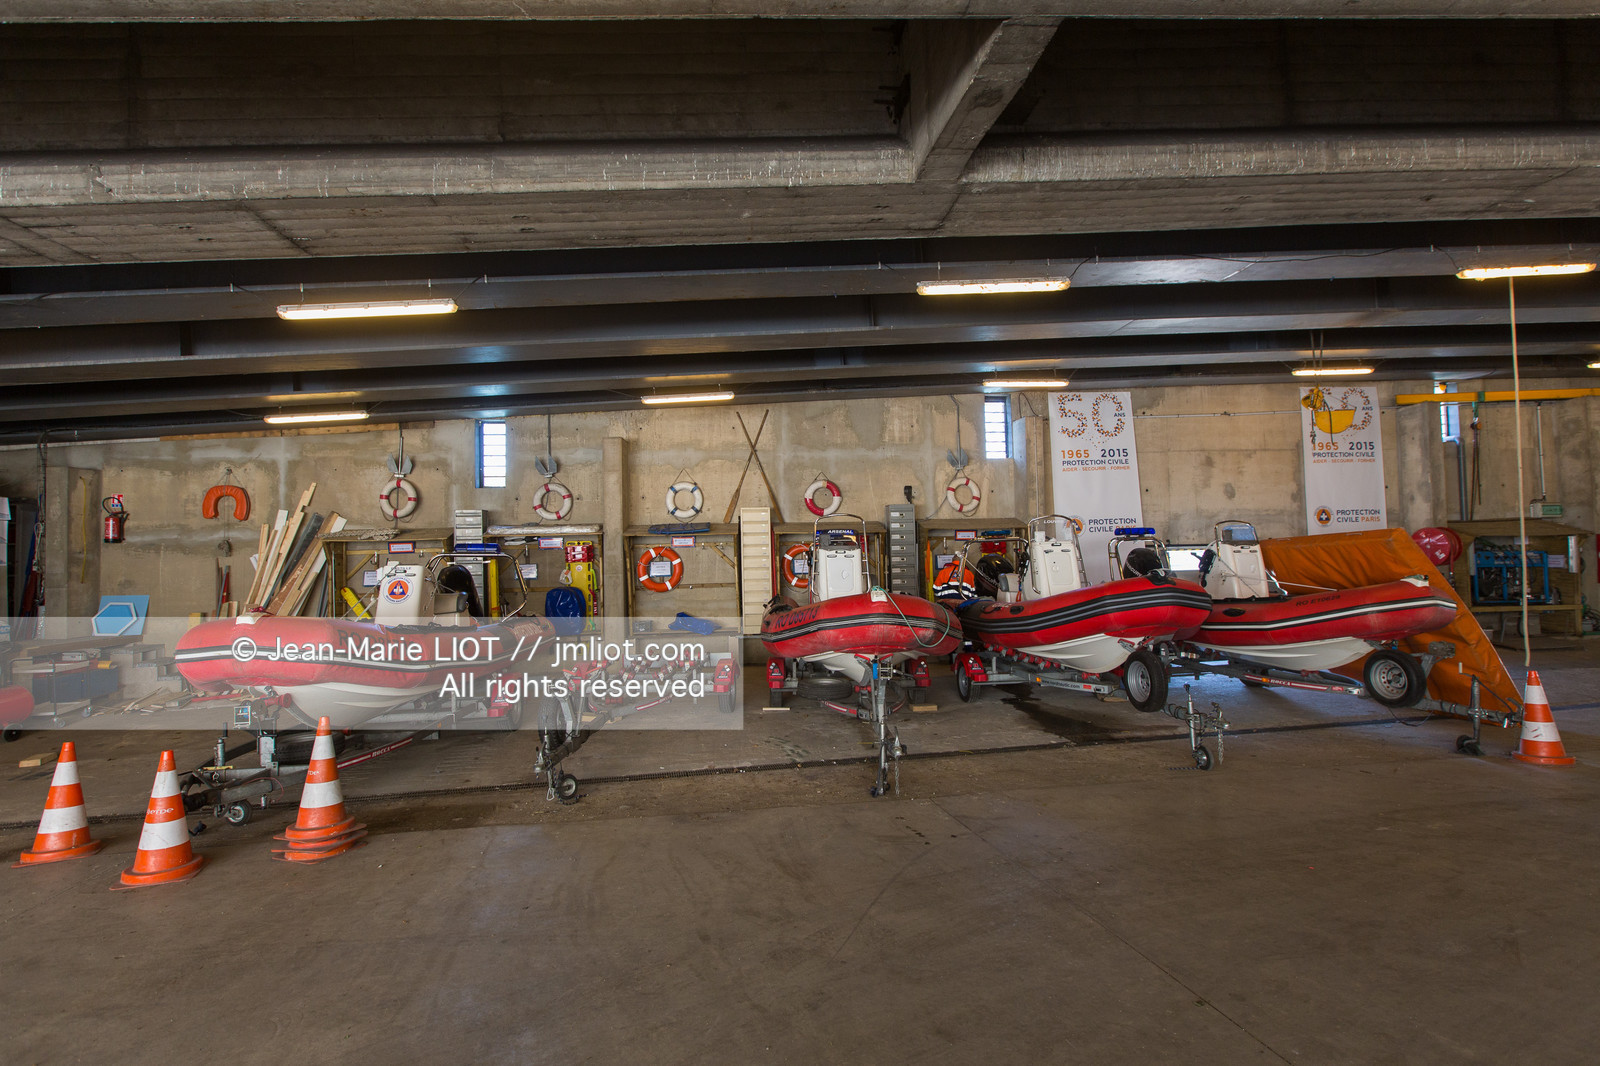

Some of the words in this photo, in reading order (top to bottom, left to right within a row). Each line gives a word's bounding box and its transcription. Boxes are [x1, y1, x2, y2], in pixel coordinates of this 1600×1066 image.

[1057, 392, 1125, 437] 50
[1312, 442, 1339, 451] 1965
[1348, 441, 1375, 450] 2015
[1061, 449, 1090, 459] 1965
[1100, 448, 1129, 458] 2015
[1062, 459, 1106, 467] PROTECTION
[1336, 508, 1381, 516] PROTECTION
[1088, 517, 1137, 525] PROTECTION
[1088, 525, 1114, 533] CIVILE
